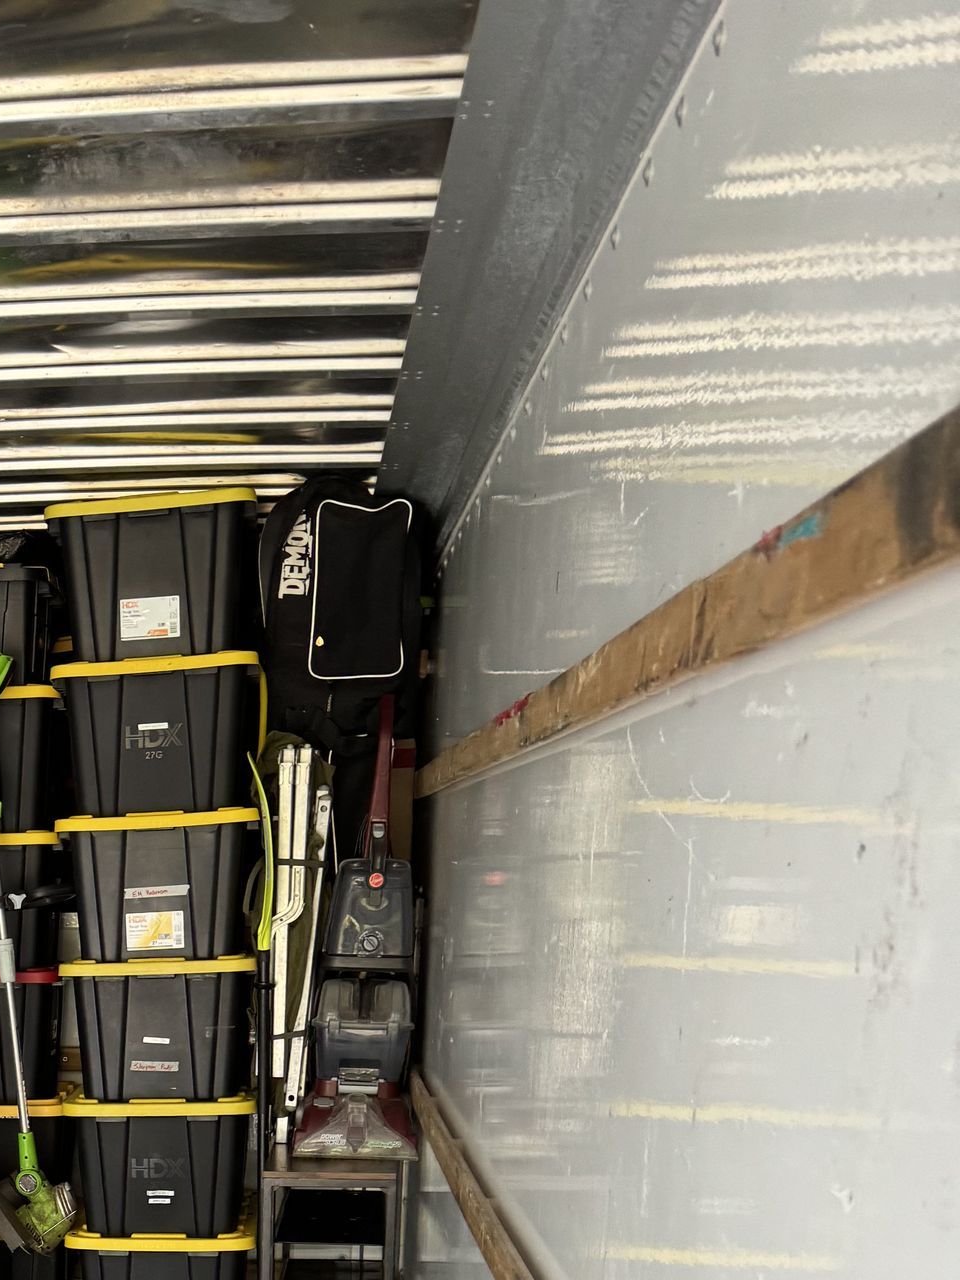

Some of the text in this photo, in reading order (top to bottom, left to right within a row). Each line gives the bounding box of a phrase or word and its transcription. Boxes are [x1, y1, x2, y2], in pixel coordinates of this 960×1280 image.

[125, 722, 183, 750] HDX
[145, 750, 163, 760] 27G
[131, 1158, 185, 1179] HDX
